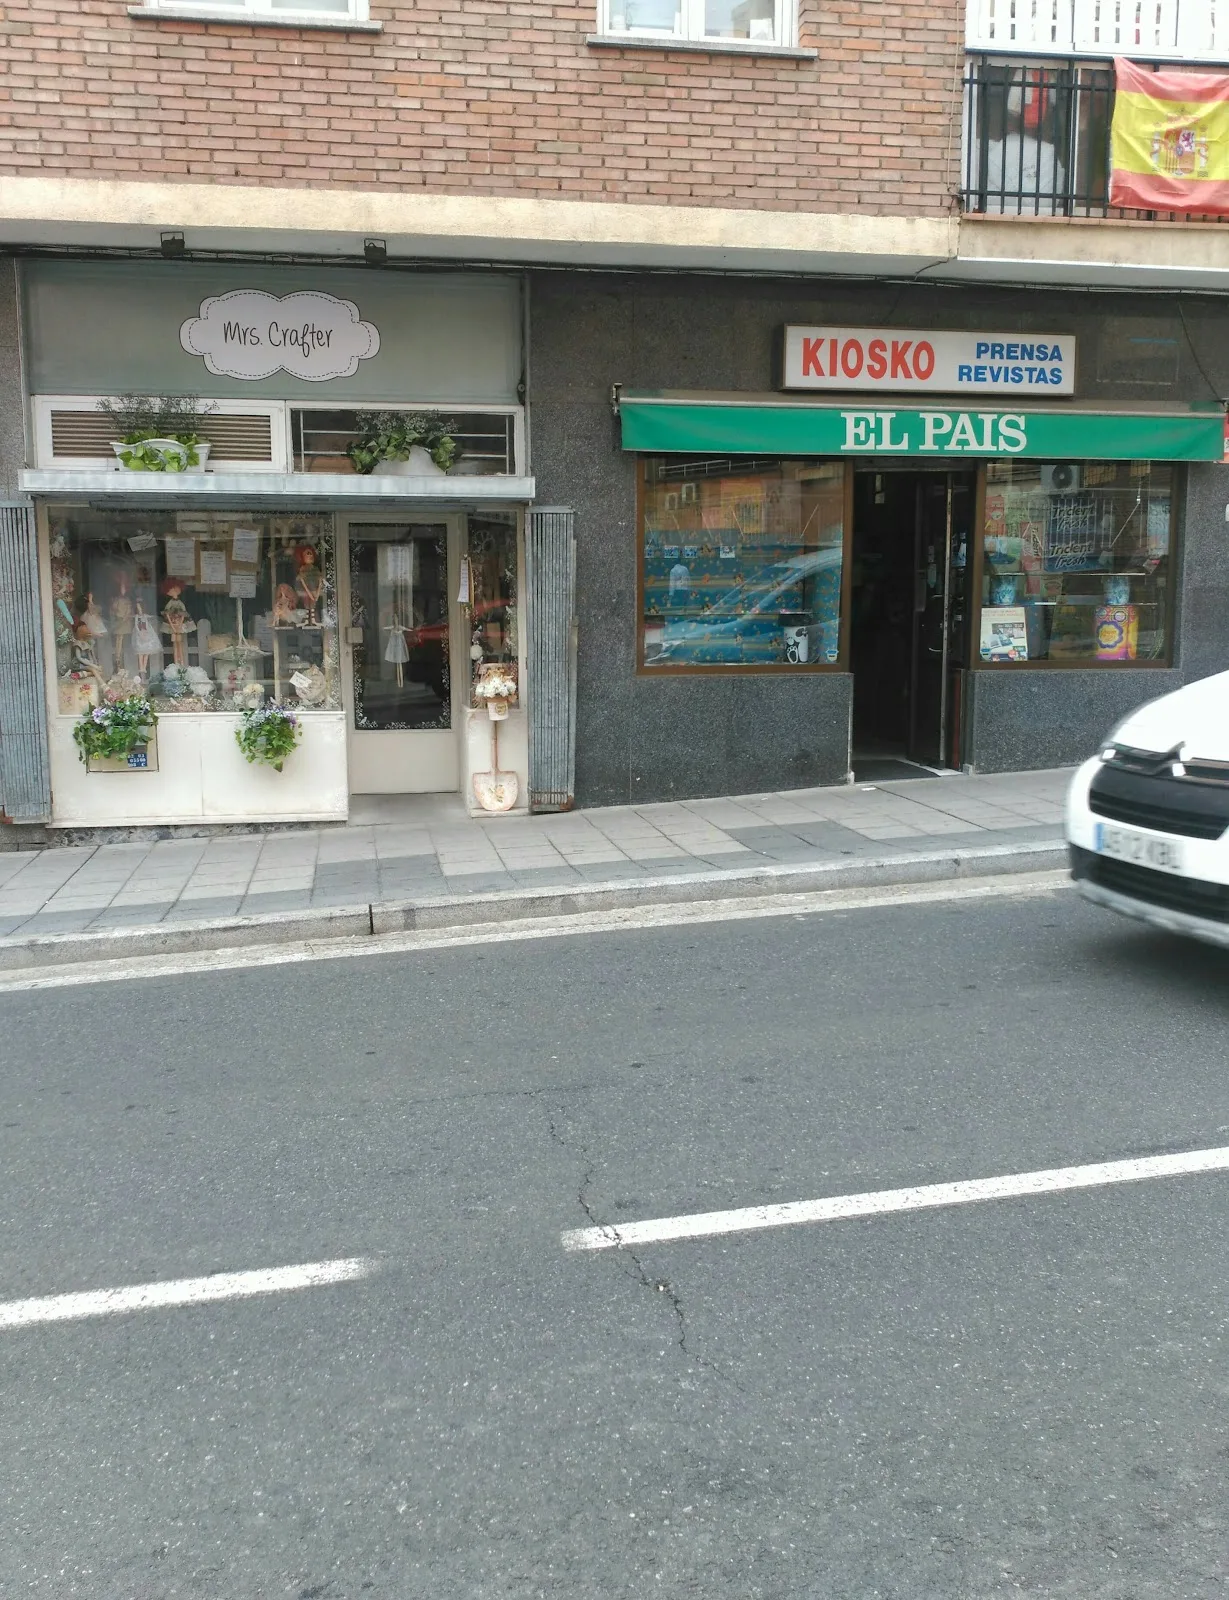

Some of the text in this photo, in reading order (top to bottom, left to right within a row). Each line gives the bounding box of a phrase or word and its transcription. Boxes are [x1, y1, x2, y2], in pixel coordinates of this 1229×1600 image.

[223, 320, 333, 358] Mrs. Crafter
[802, 337, 935, 380] KIOSKO
[976, 342, 1063, 362] PRENSA
[958, 365, 1063, 385] REVISTAS
[840, 412, 1027, 453] EL PAIS
[1051, 503, 1094, 518] Trident
[1049, 541, 1093, 557] Trident
